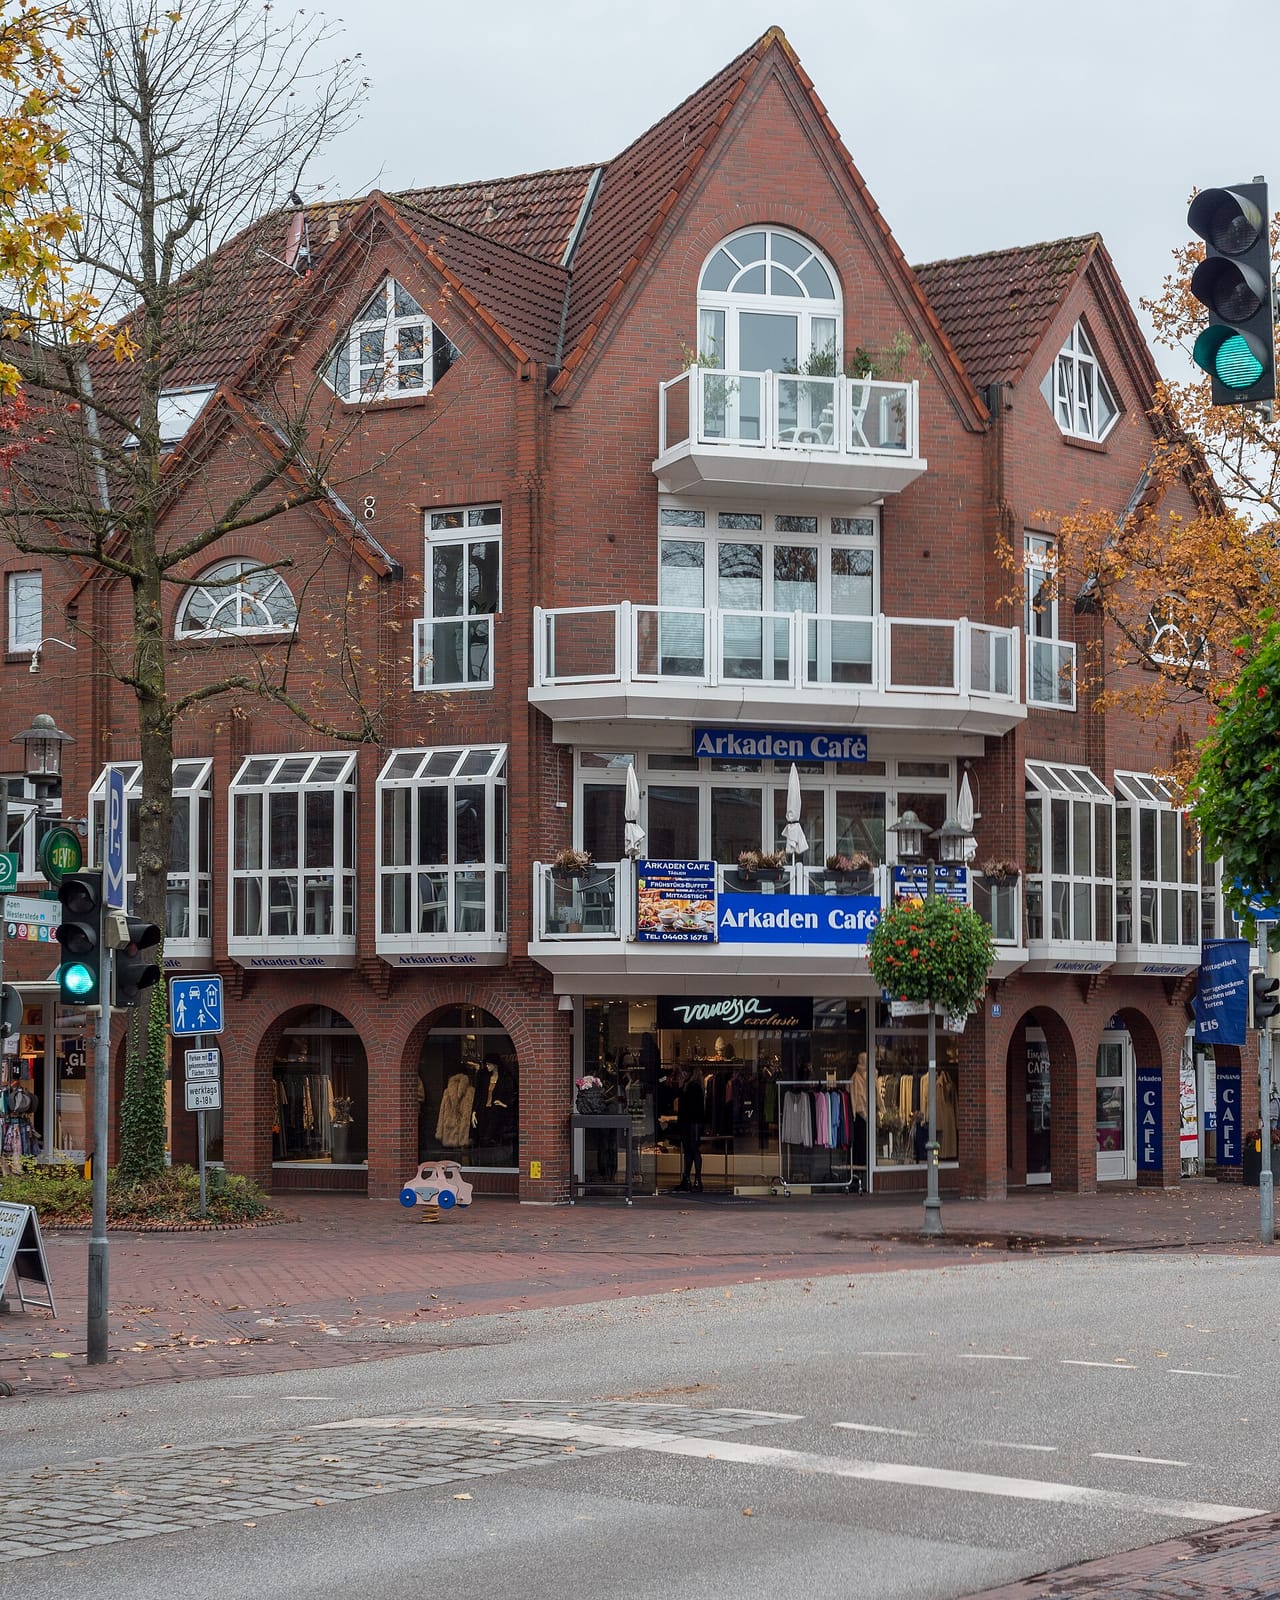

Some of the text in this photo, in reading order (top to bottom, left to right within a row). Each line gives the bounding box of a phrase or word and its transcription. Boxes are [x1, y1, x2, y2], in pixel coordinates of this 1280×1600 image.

[696, 733, 867, 759] Arkaden Café
[52, 846, 77, 869] JEVER
[644, 861, 686, 870] ARKADEN
[6, 910, 39, 920] Westerstede
[720, 908, 878, 930] Arkaden Café
[163, 959, 182, 967] afé
[250, 957, 325, 967] Arkaden Café
[399, 955, 477, 964] Arkaden Café
[673, 997, 772, 1025] vanessa
[743, 1013, 800, 1026] exclusiv
[1200, 1019, 1219, 1033] EIS
[189, 1086, 218, 1096] werktags
